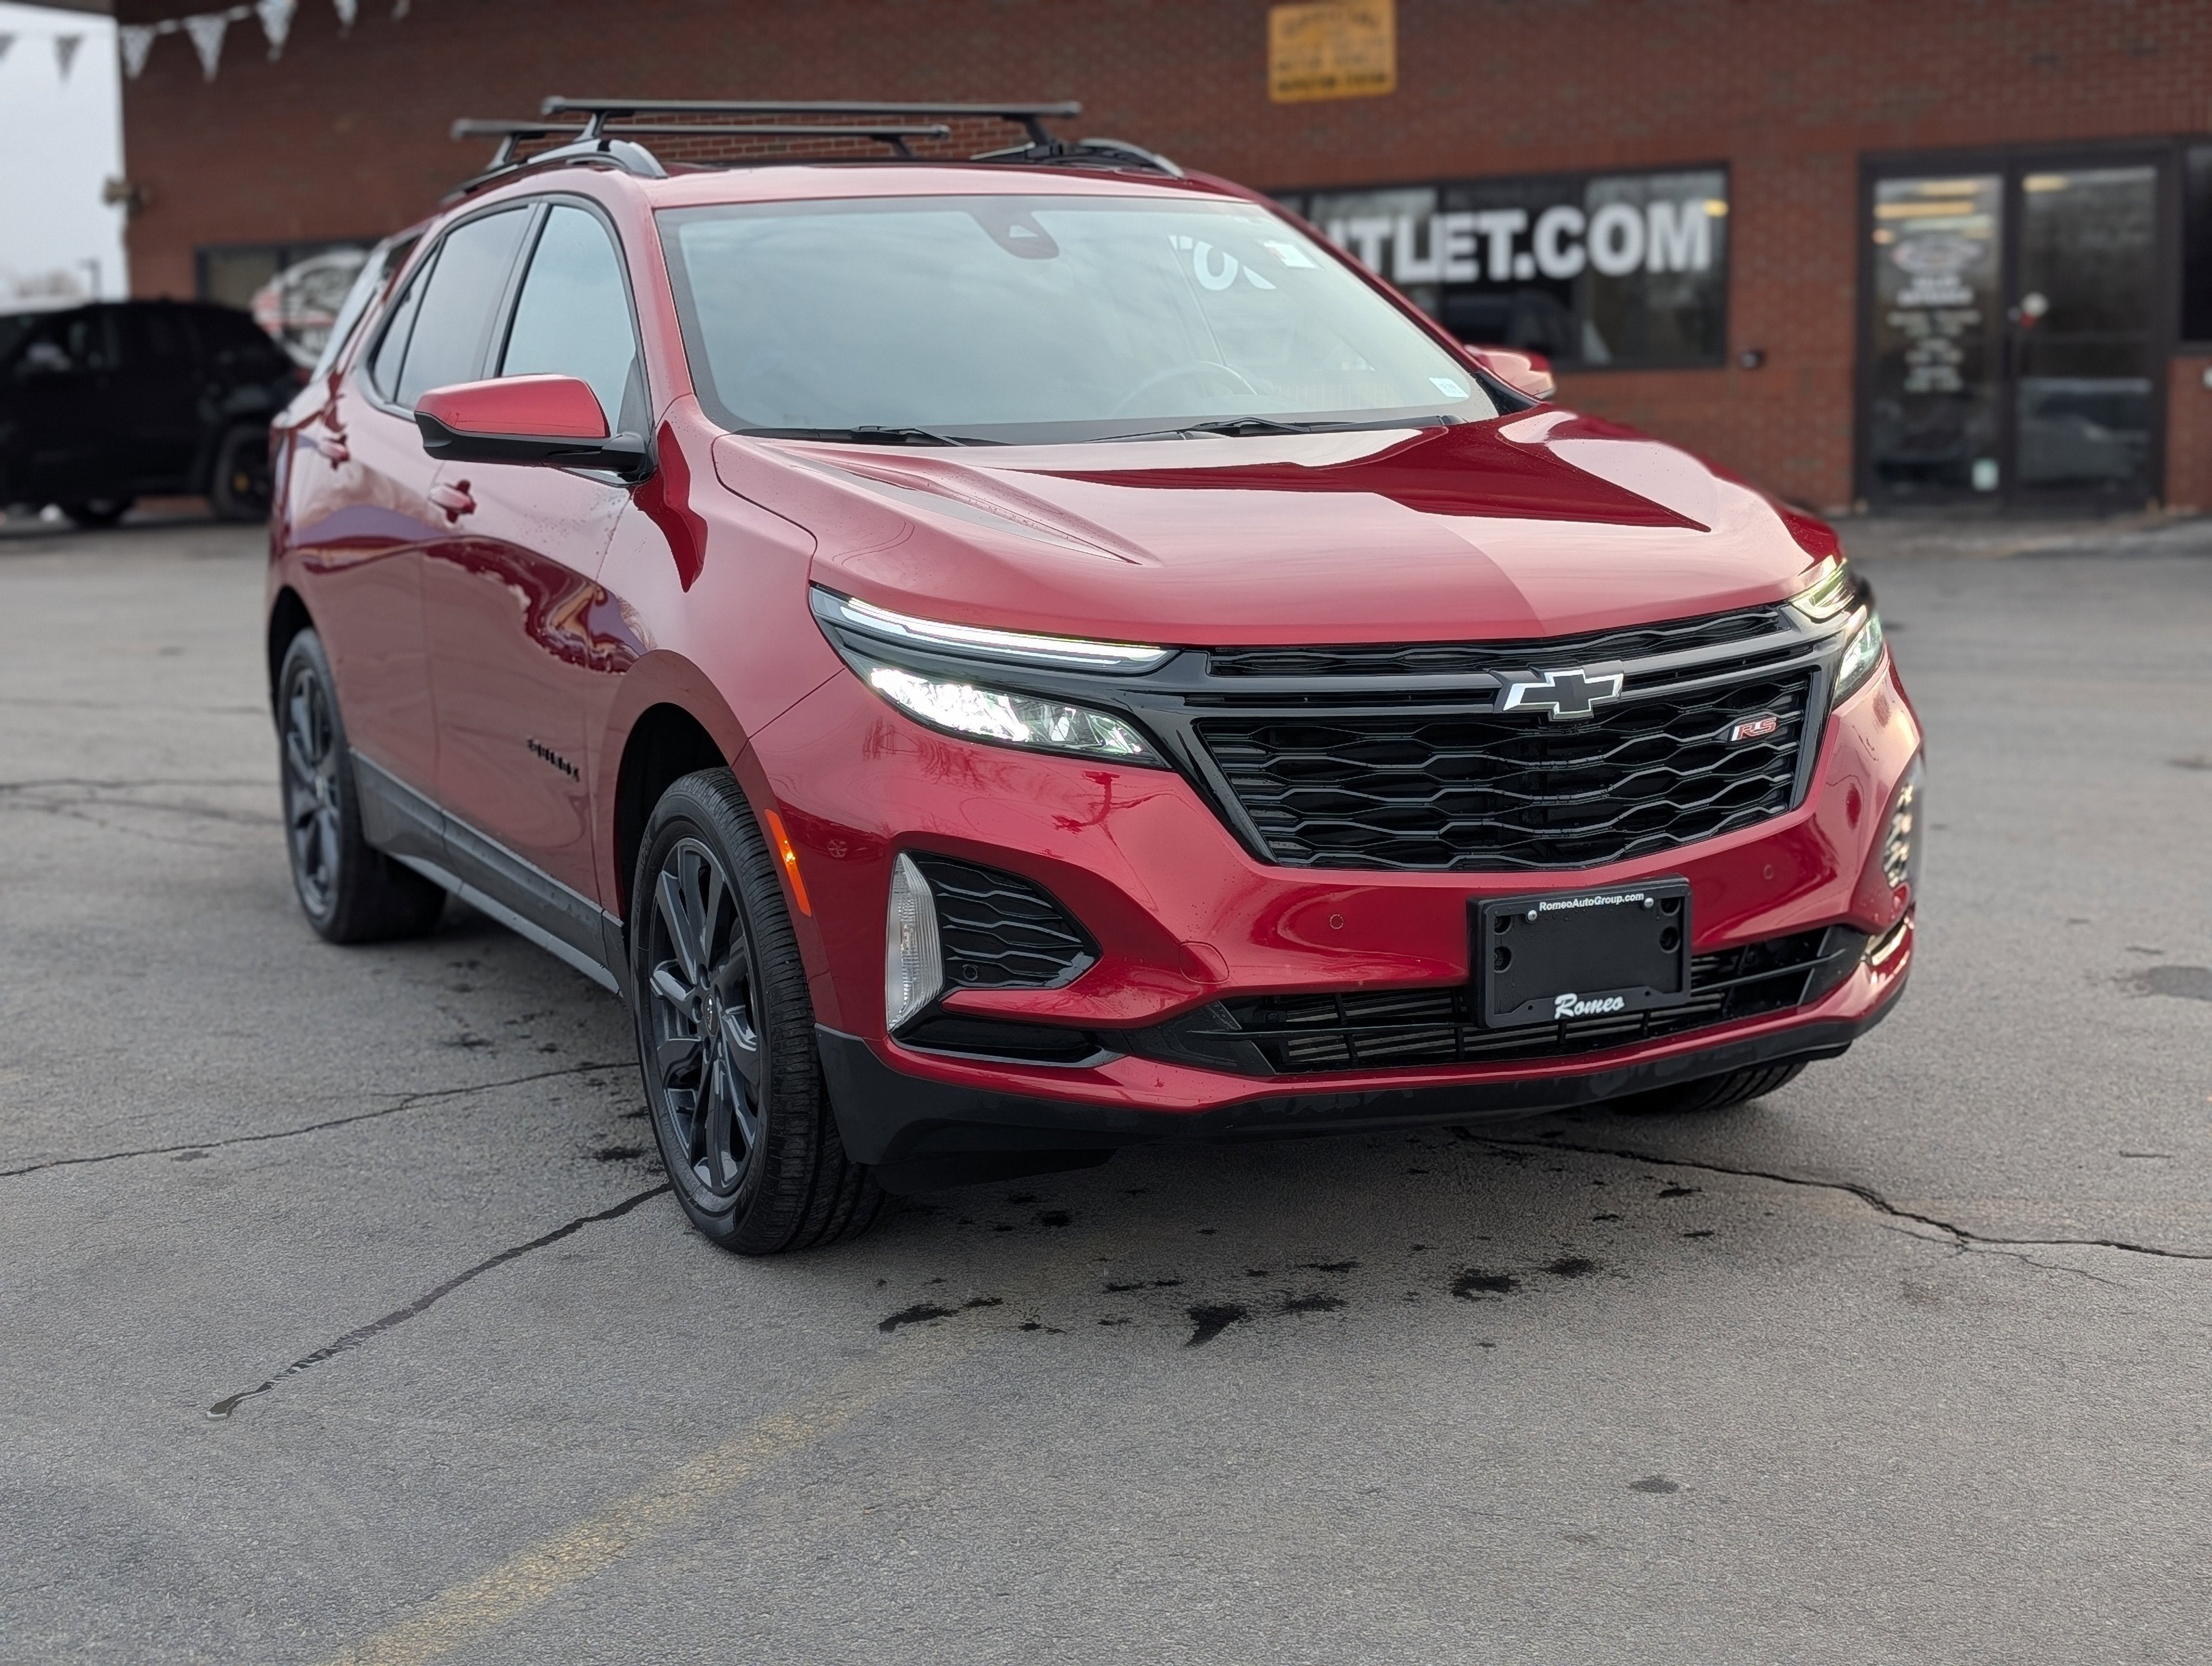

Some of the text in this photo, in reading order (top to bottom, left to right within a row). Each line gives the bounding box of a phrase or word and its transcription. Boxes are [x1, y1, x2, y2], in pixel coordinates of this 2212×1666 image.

[1731, 717, 1777, 741] RS
[1539, 893, 1644, 912] RomeoAutoGroup.com
[1554, 993, 1625, 1020] Romeo
